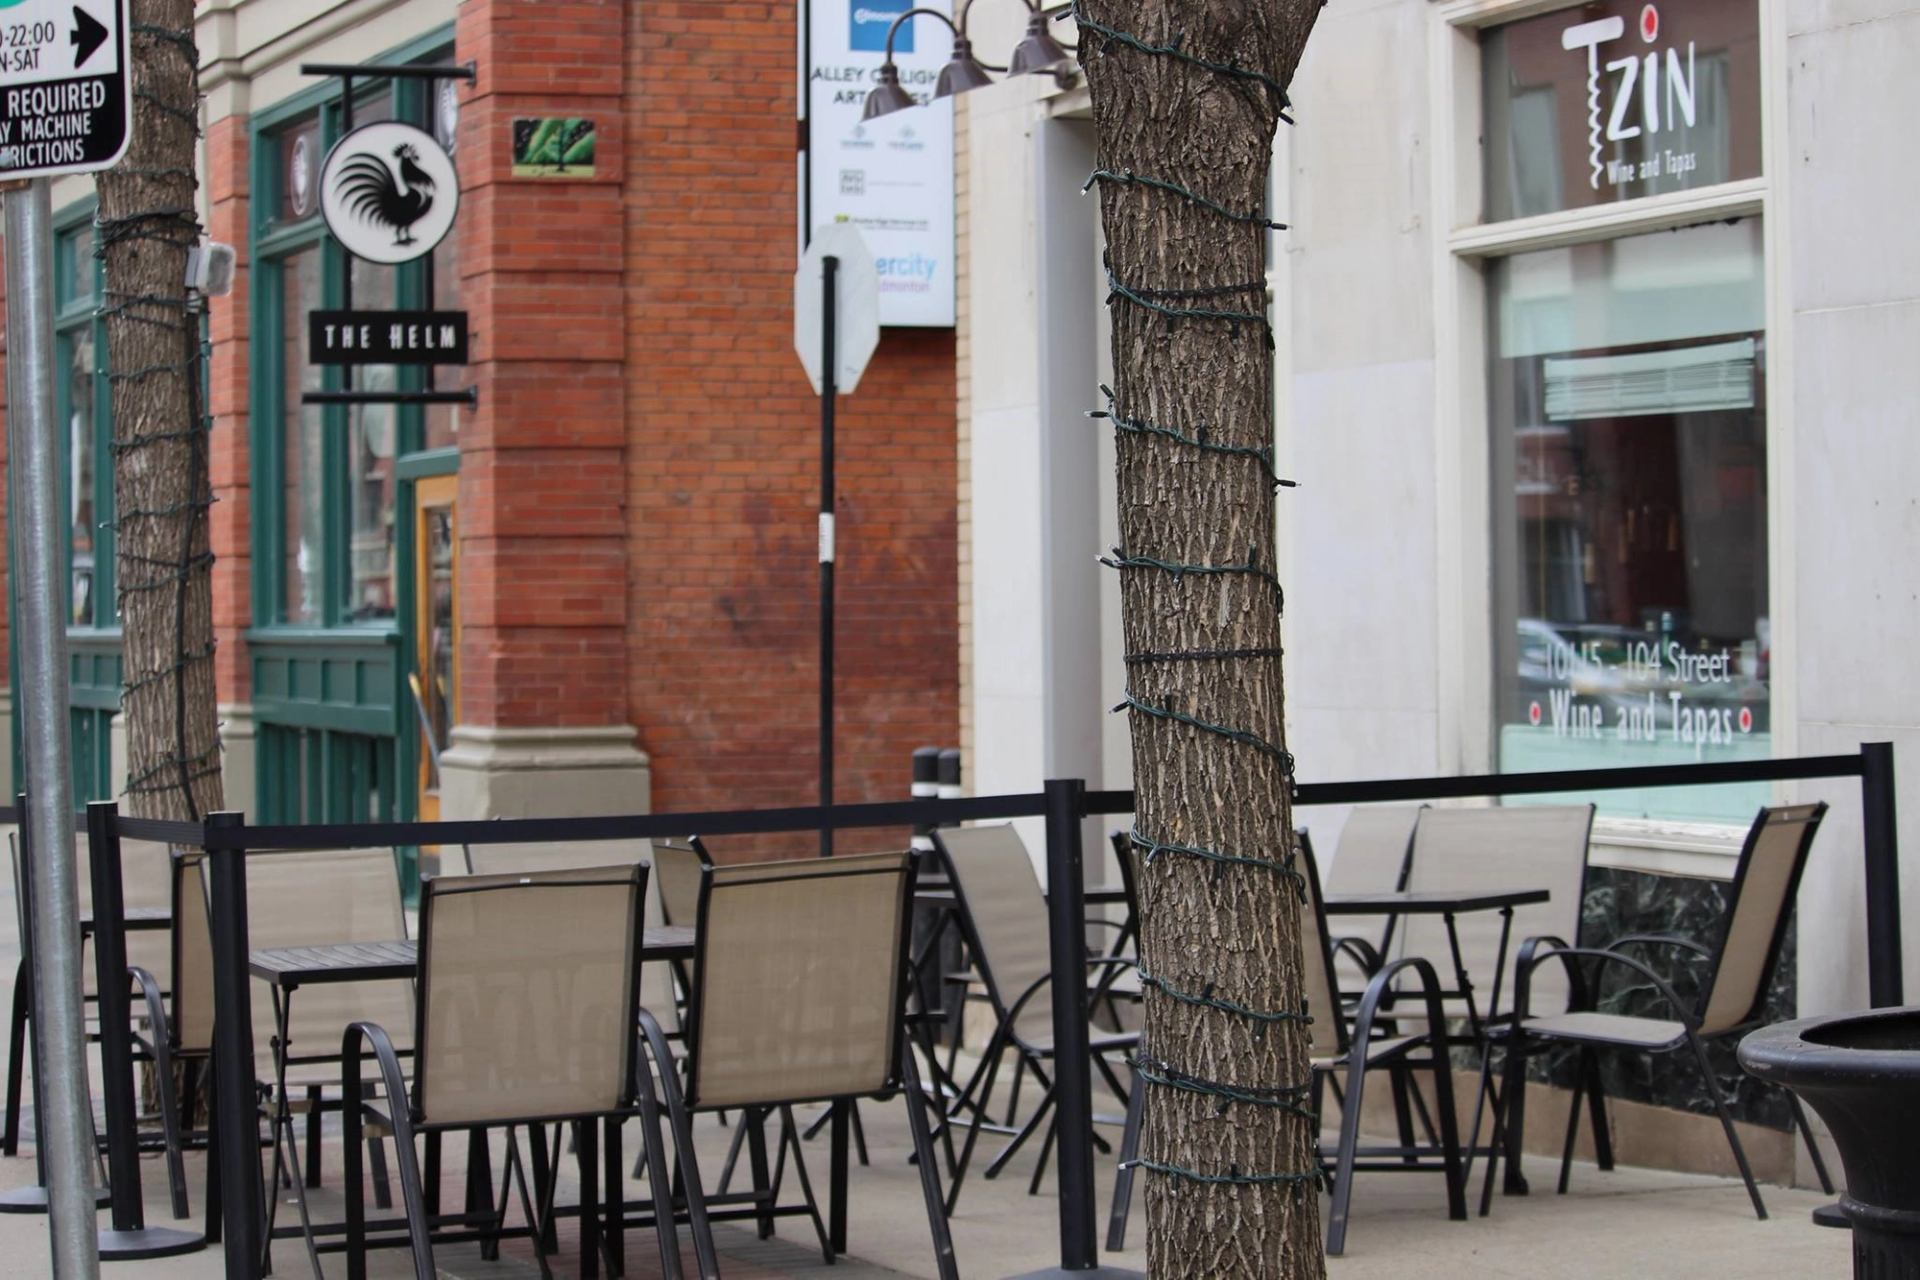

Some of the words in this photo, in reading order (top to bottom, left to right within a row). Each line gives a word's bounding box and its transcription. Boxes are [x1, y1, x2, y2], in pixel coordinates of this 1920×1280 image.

[0, 20, 55, 48] -22:00
[812, 67, 864, 82] ALLEY
[8, 81, 106, 119] REQUIRED
[834, 91, 867, 104] ART
[0, 121, 11, 144] Y
[21, 112, 92, 142] MACHINE
[1640, 152, 1660, 179] and
[1665, 149, 1697, 180] Tapas
[325, 324, 371, 349] THE
[389, 323, 456, 350] HELM
[1627, 641, 1662, 680] 104
[1668, 642, 1731, 683] Street
[1550, 689, 1603, 739] Wine
[1616, 691, 1656, 741] and
[1669, 691, 1733, 759] Tapas
